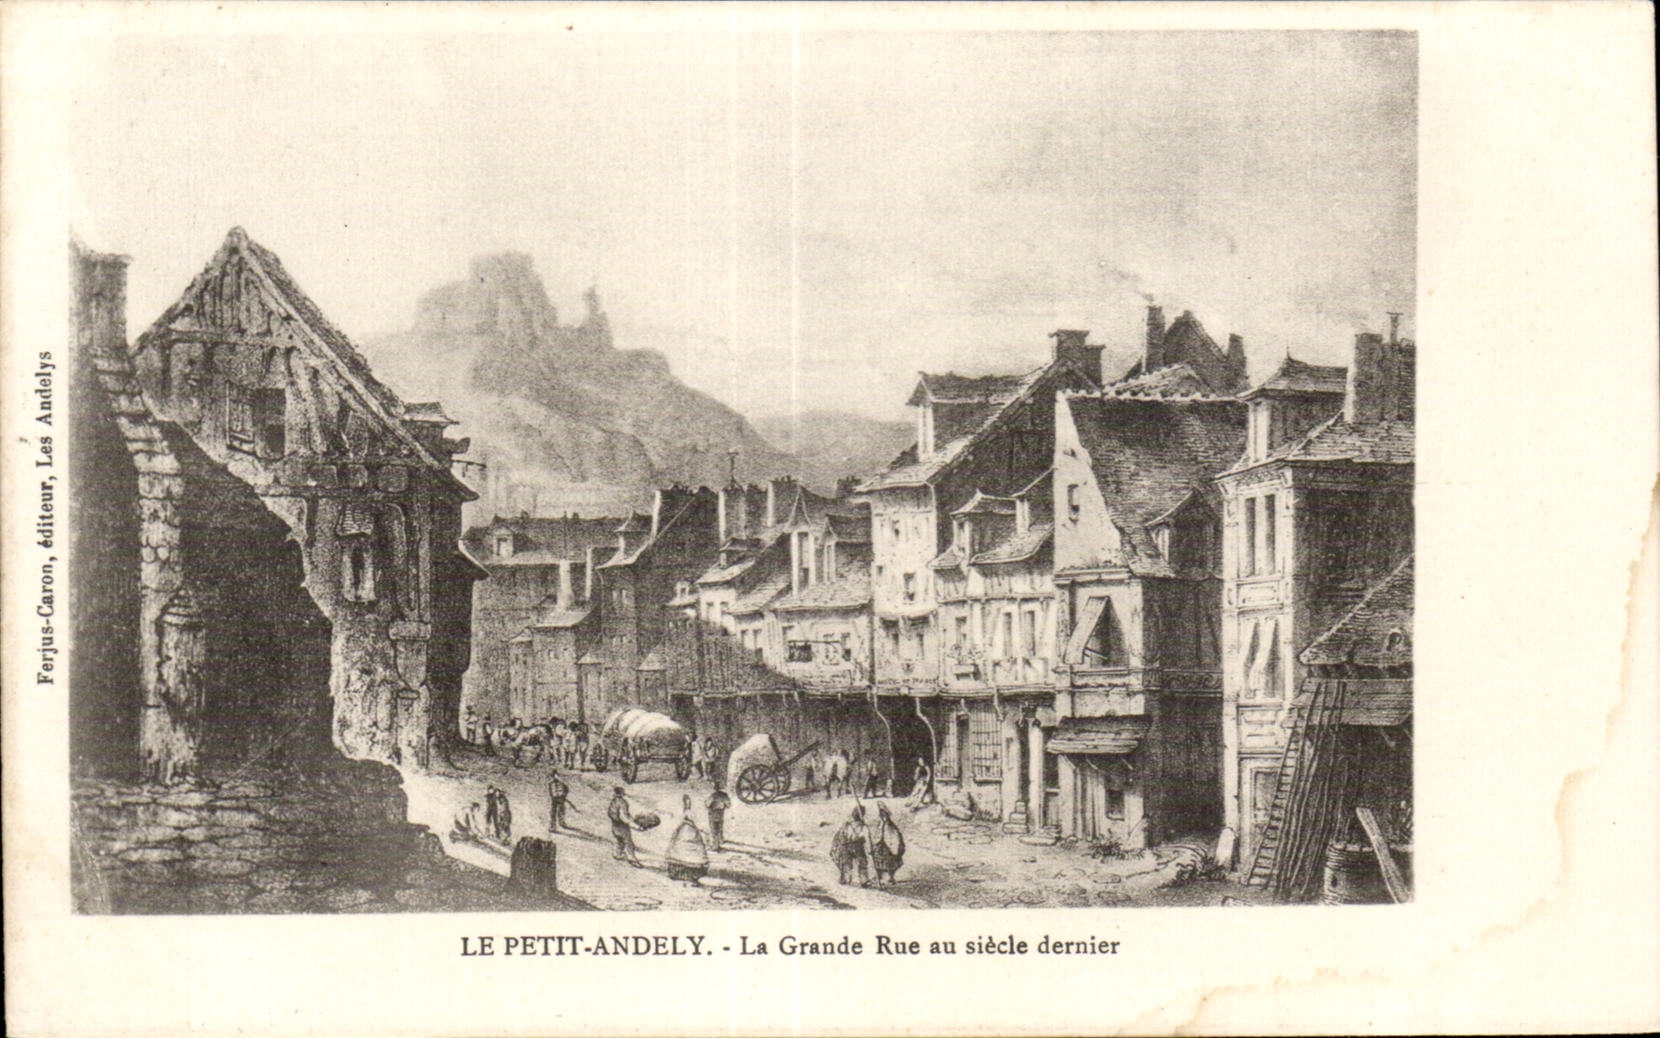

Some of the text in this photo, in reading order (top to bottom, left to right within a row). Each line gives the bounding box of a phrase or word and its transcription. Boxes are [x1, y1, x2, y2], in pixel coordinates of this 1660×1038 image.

[35, 351, 58, 684] Ferjus-Caron, éditeur, Les Andelys
[461, 936, 494, 956] LE
[504, 936, 712, 956] PETIT-ANDELY.
[740, 936, 768, 955] La
[779, 935, 863, 956] Grande
[875, 936, 920, 955] Rue
[929, 941, 956, 955] au
[966, 935, 1028, 955] siècle
[1037, 935, 1120, 955] dernier
